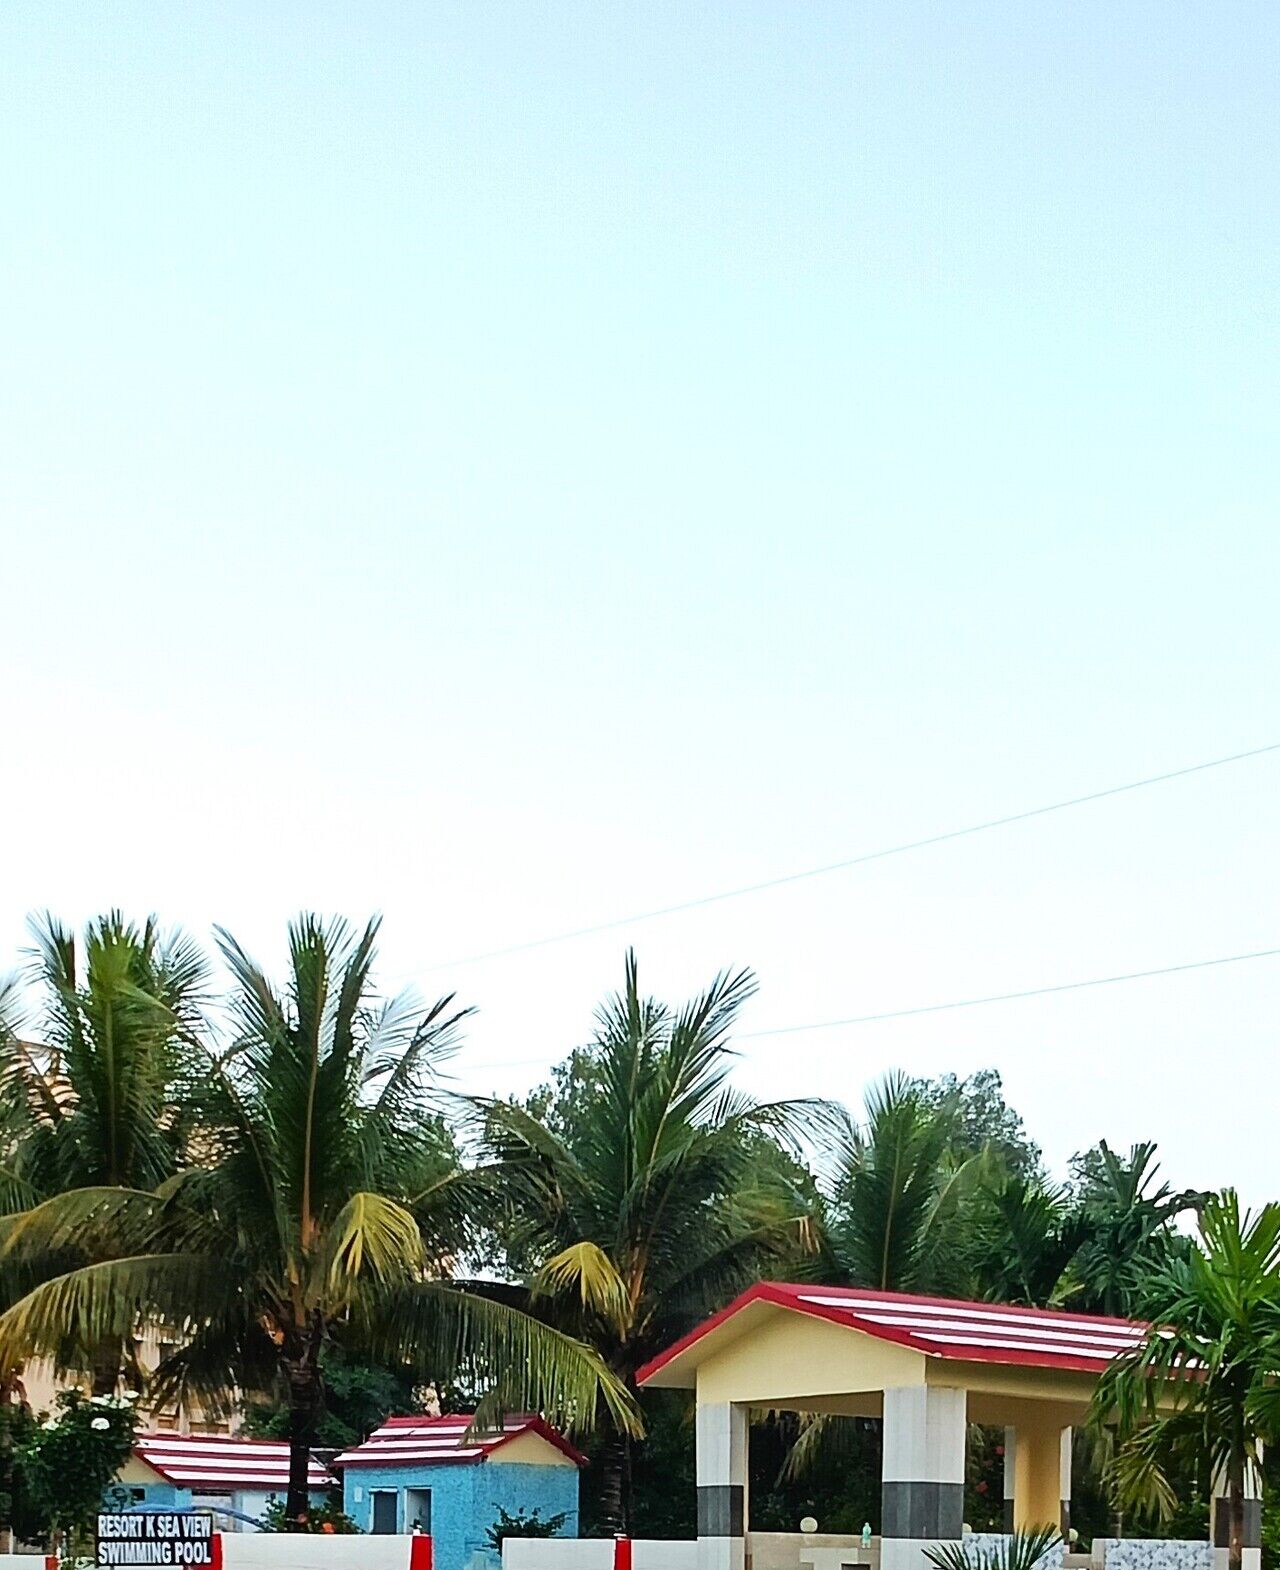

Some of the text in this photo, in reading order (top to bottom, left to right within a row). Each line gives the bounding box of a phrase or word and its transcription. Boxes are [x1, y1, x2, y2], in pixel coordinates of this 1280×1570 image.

[98, 1515, 211, 1537] RESORT K SEA VIEW
[98, 1541, 211, 1563] SWIMMING POOL
